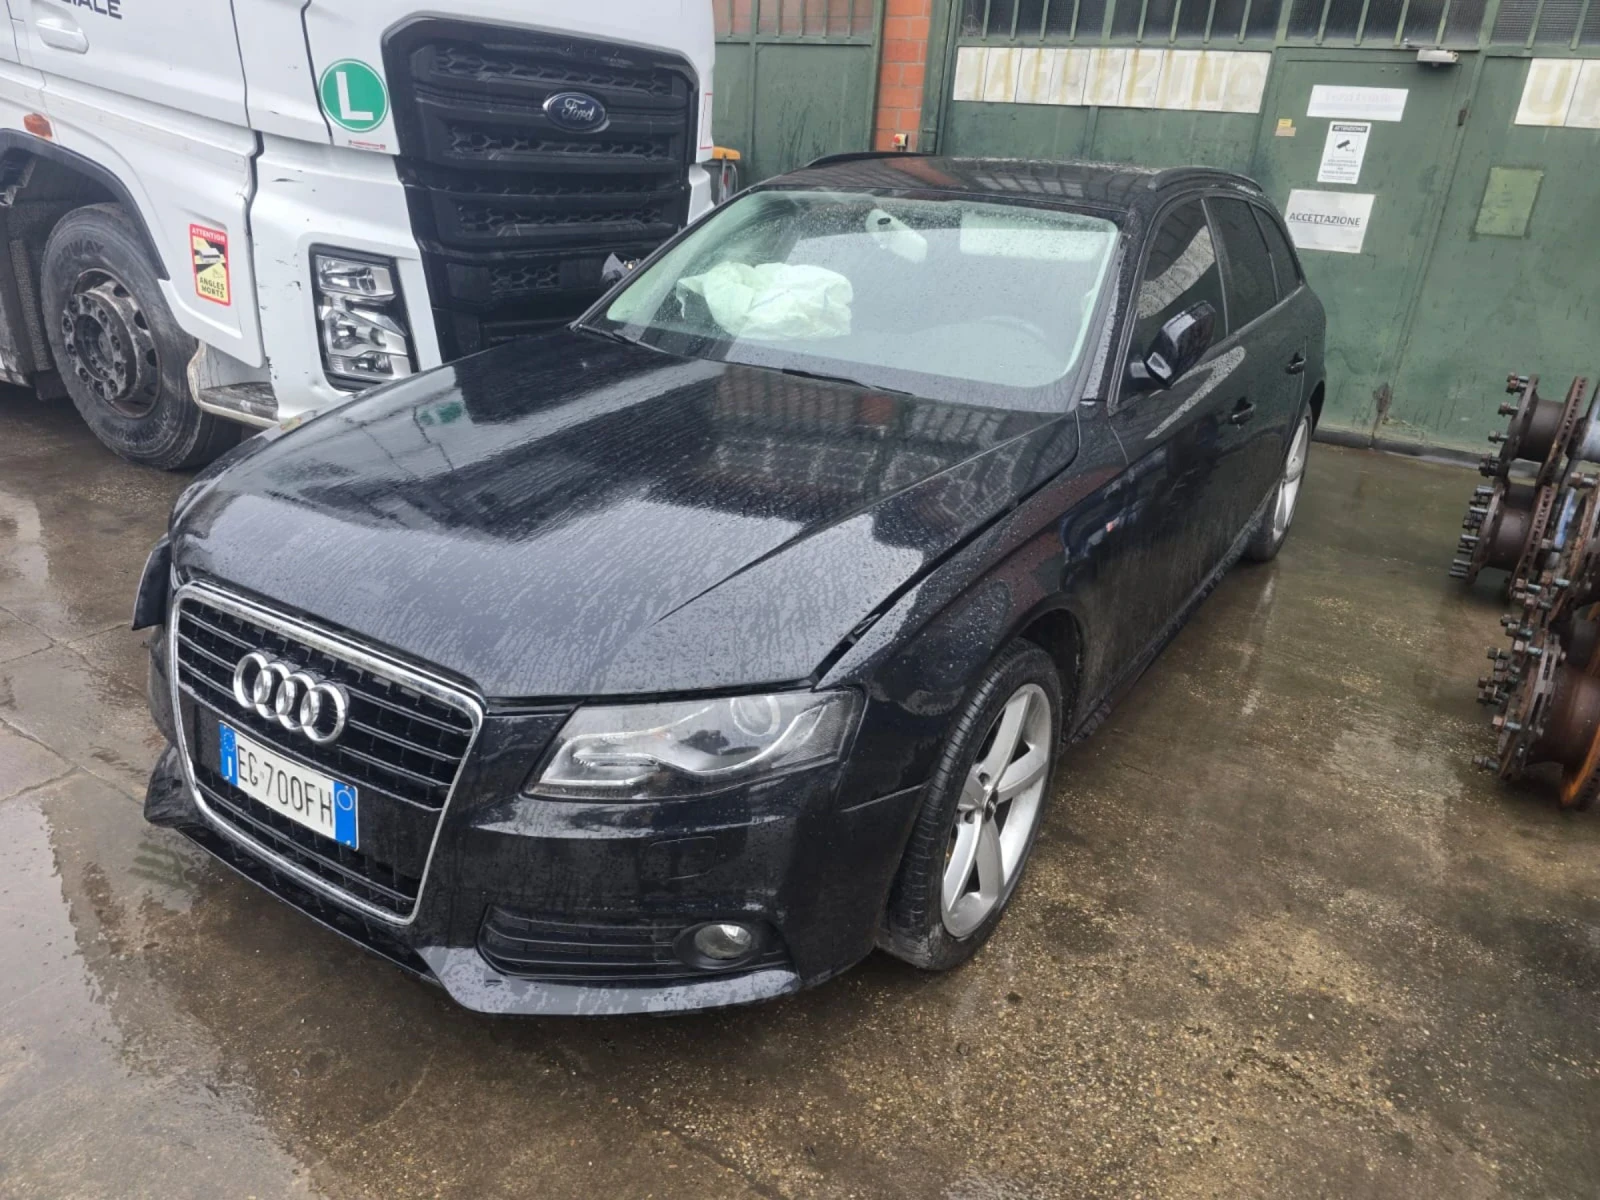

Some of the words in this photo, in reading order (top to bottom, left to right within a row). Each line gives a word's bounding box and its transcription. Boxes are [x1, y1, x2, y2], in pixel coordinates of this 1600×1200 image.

[336, 71, 374, 121] L
[561, 97, 596, 122] Ford
[1289, 212, 1361, 226] ACCETTAZIONE
[191, 227, 226, 241] ATTENTION
[199, 276, 225, 291] ANGLES
[201, 284, 225, 298] MORTS
